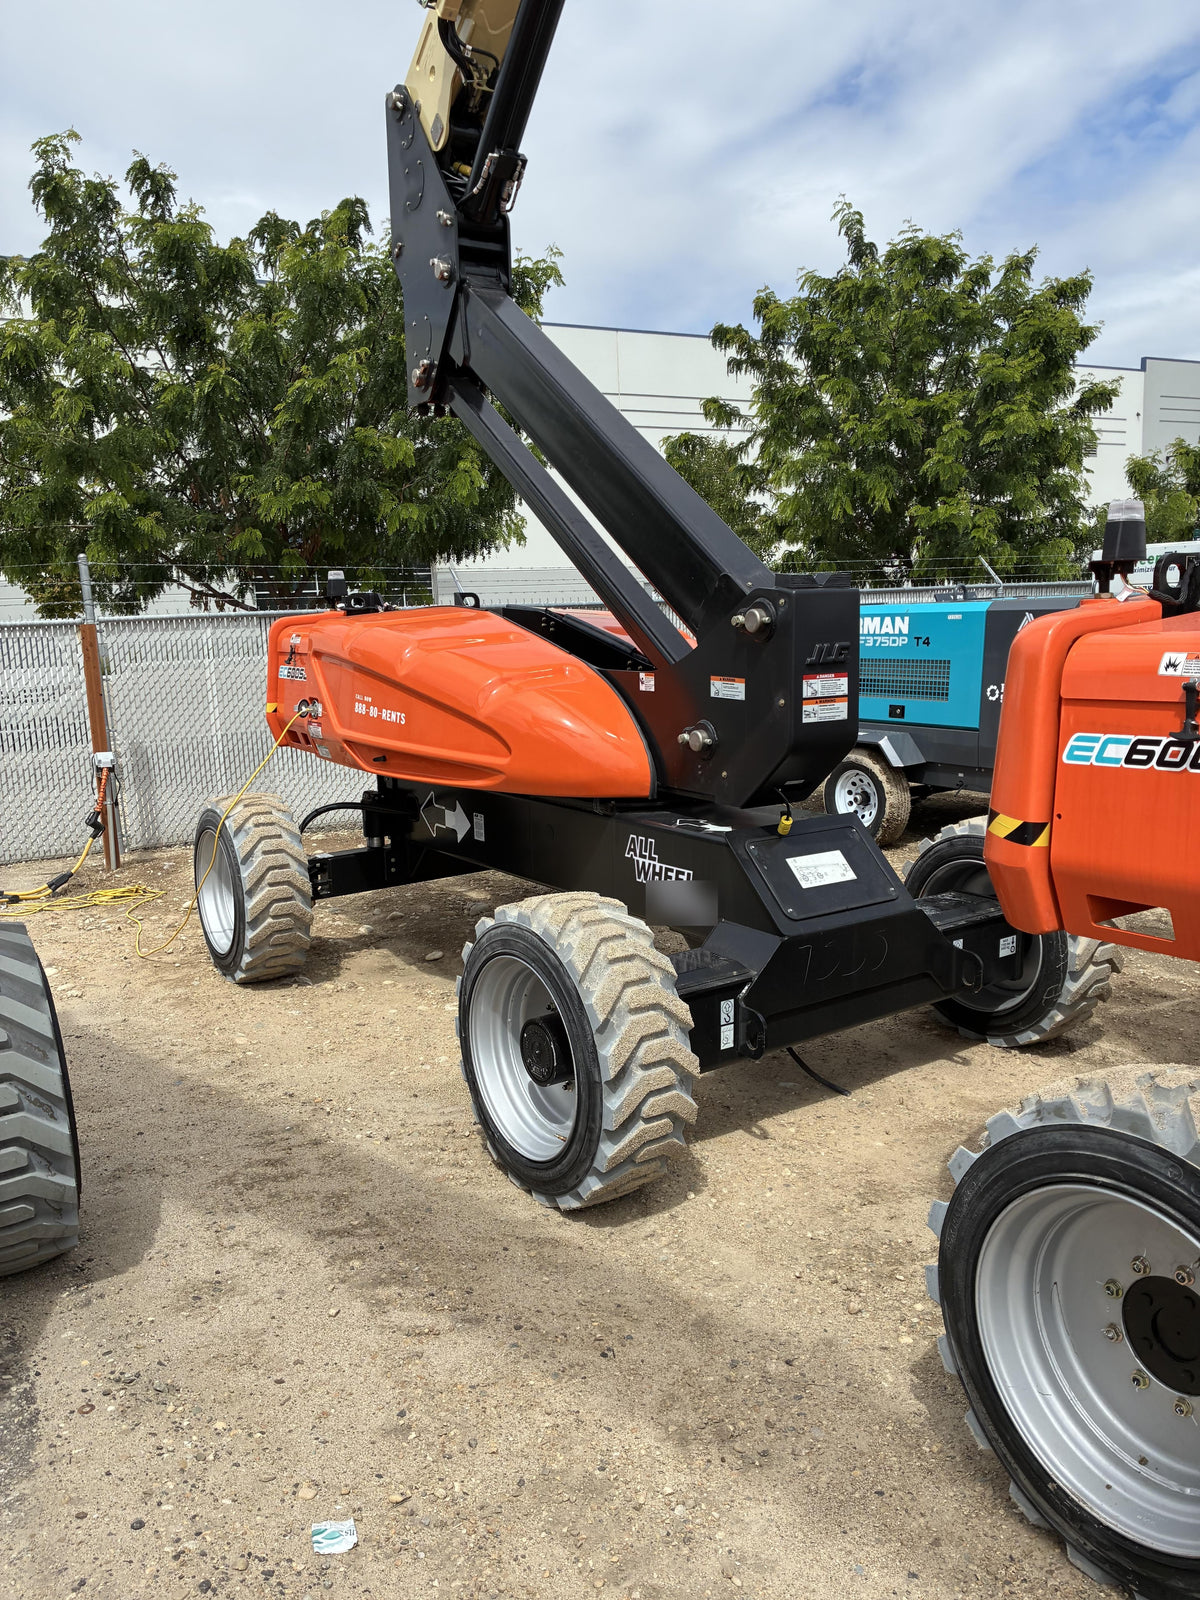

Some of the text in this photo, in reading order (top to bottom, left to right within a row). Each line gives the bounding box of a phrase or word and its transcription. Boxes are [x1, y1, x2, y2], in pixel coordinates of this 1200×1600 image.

[914, 636, 931, 647] T4
[354, 702, 406, 724] 888-80-RENTS
[625, 834, 659, 863] ALL
